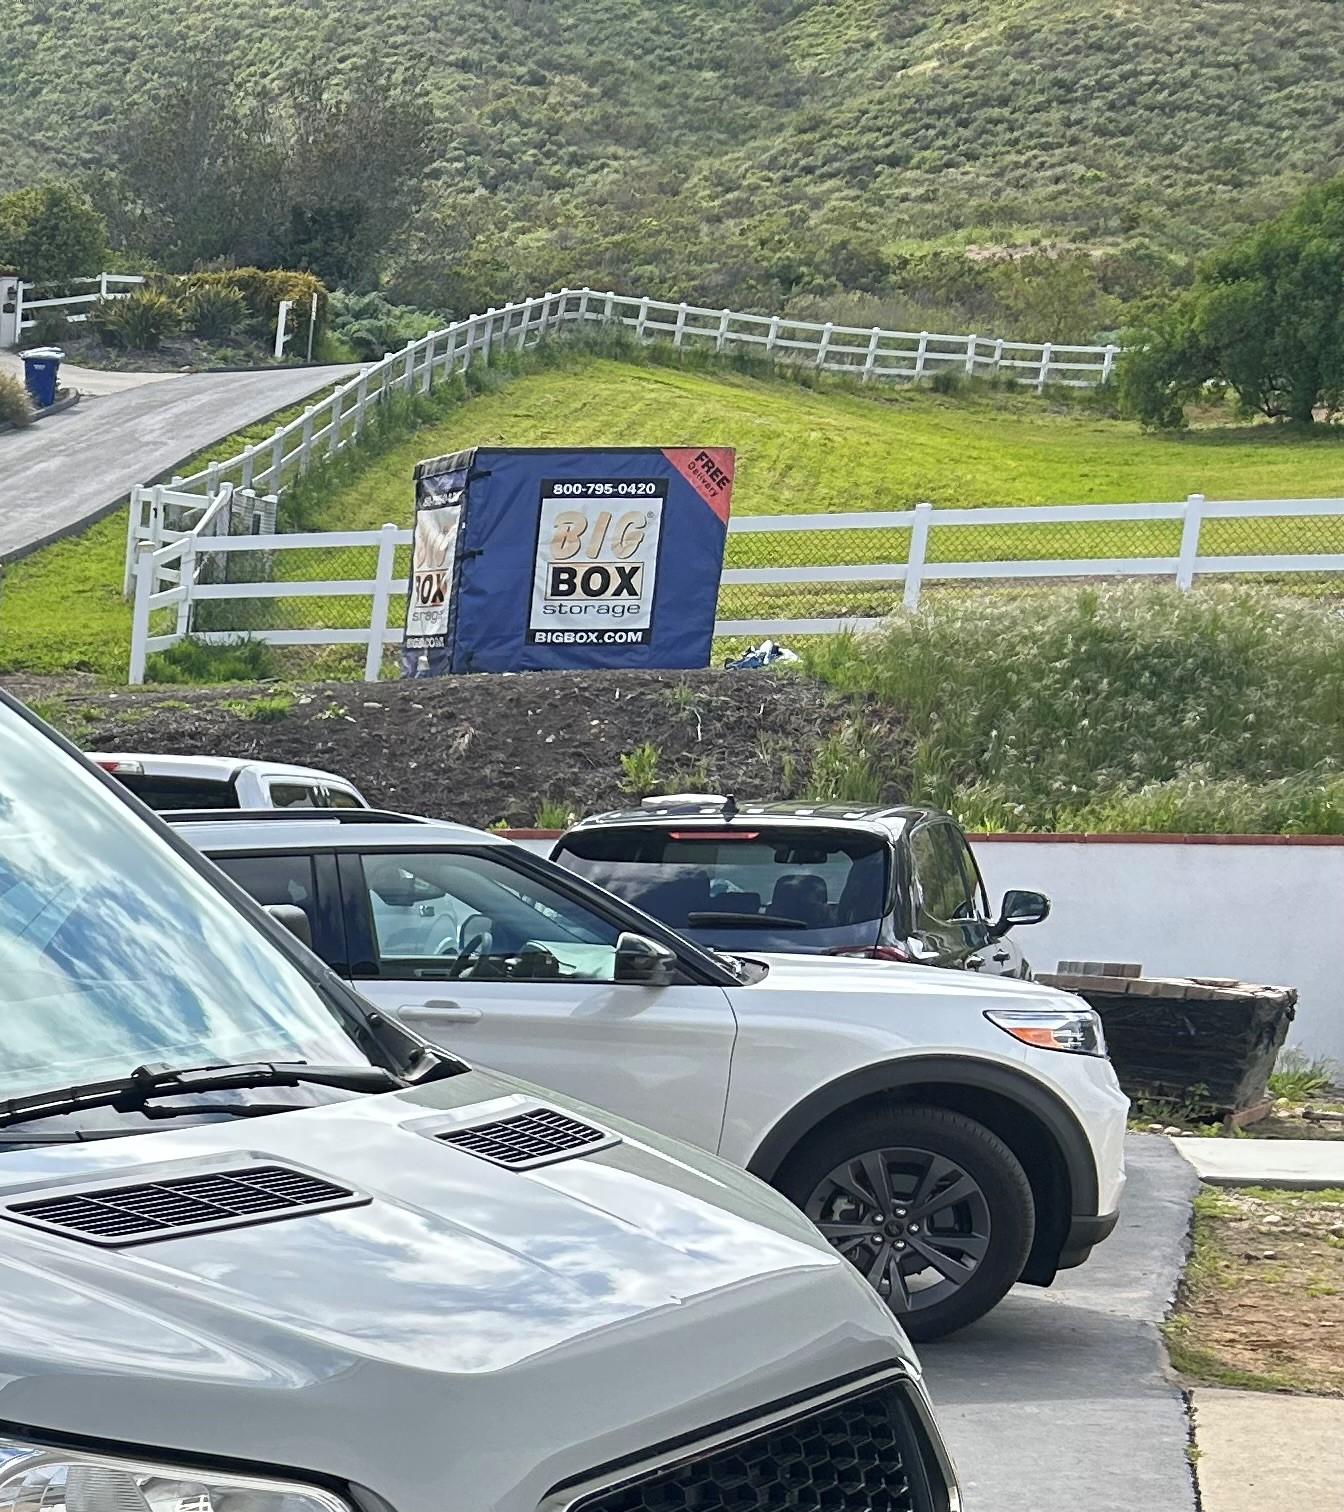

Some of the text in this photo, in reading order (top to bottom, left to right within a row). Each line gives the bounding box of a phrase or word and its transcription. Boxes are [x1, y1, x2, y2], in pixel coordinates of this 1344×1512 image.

[687, 461, 719, 497] Delivery
[694, 451, 730, 491] FREE
[553, 483, 656, 495] 800-795-0420
[550, 511, 647, 559] BIG
[550, 566, 640, 597] BOX
[543, 602, 641, 618] storage
[535, 631, 643, 643] BIGBOX.COM
